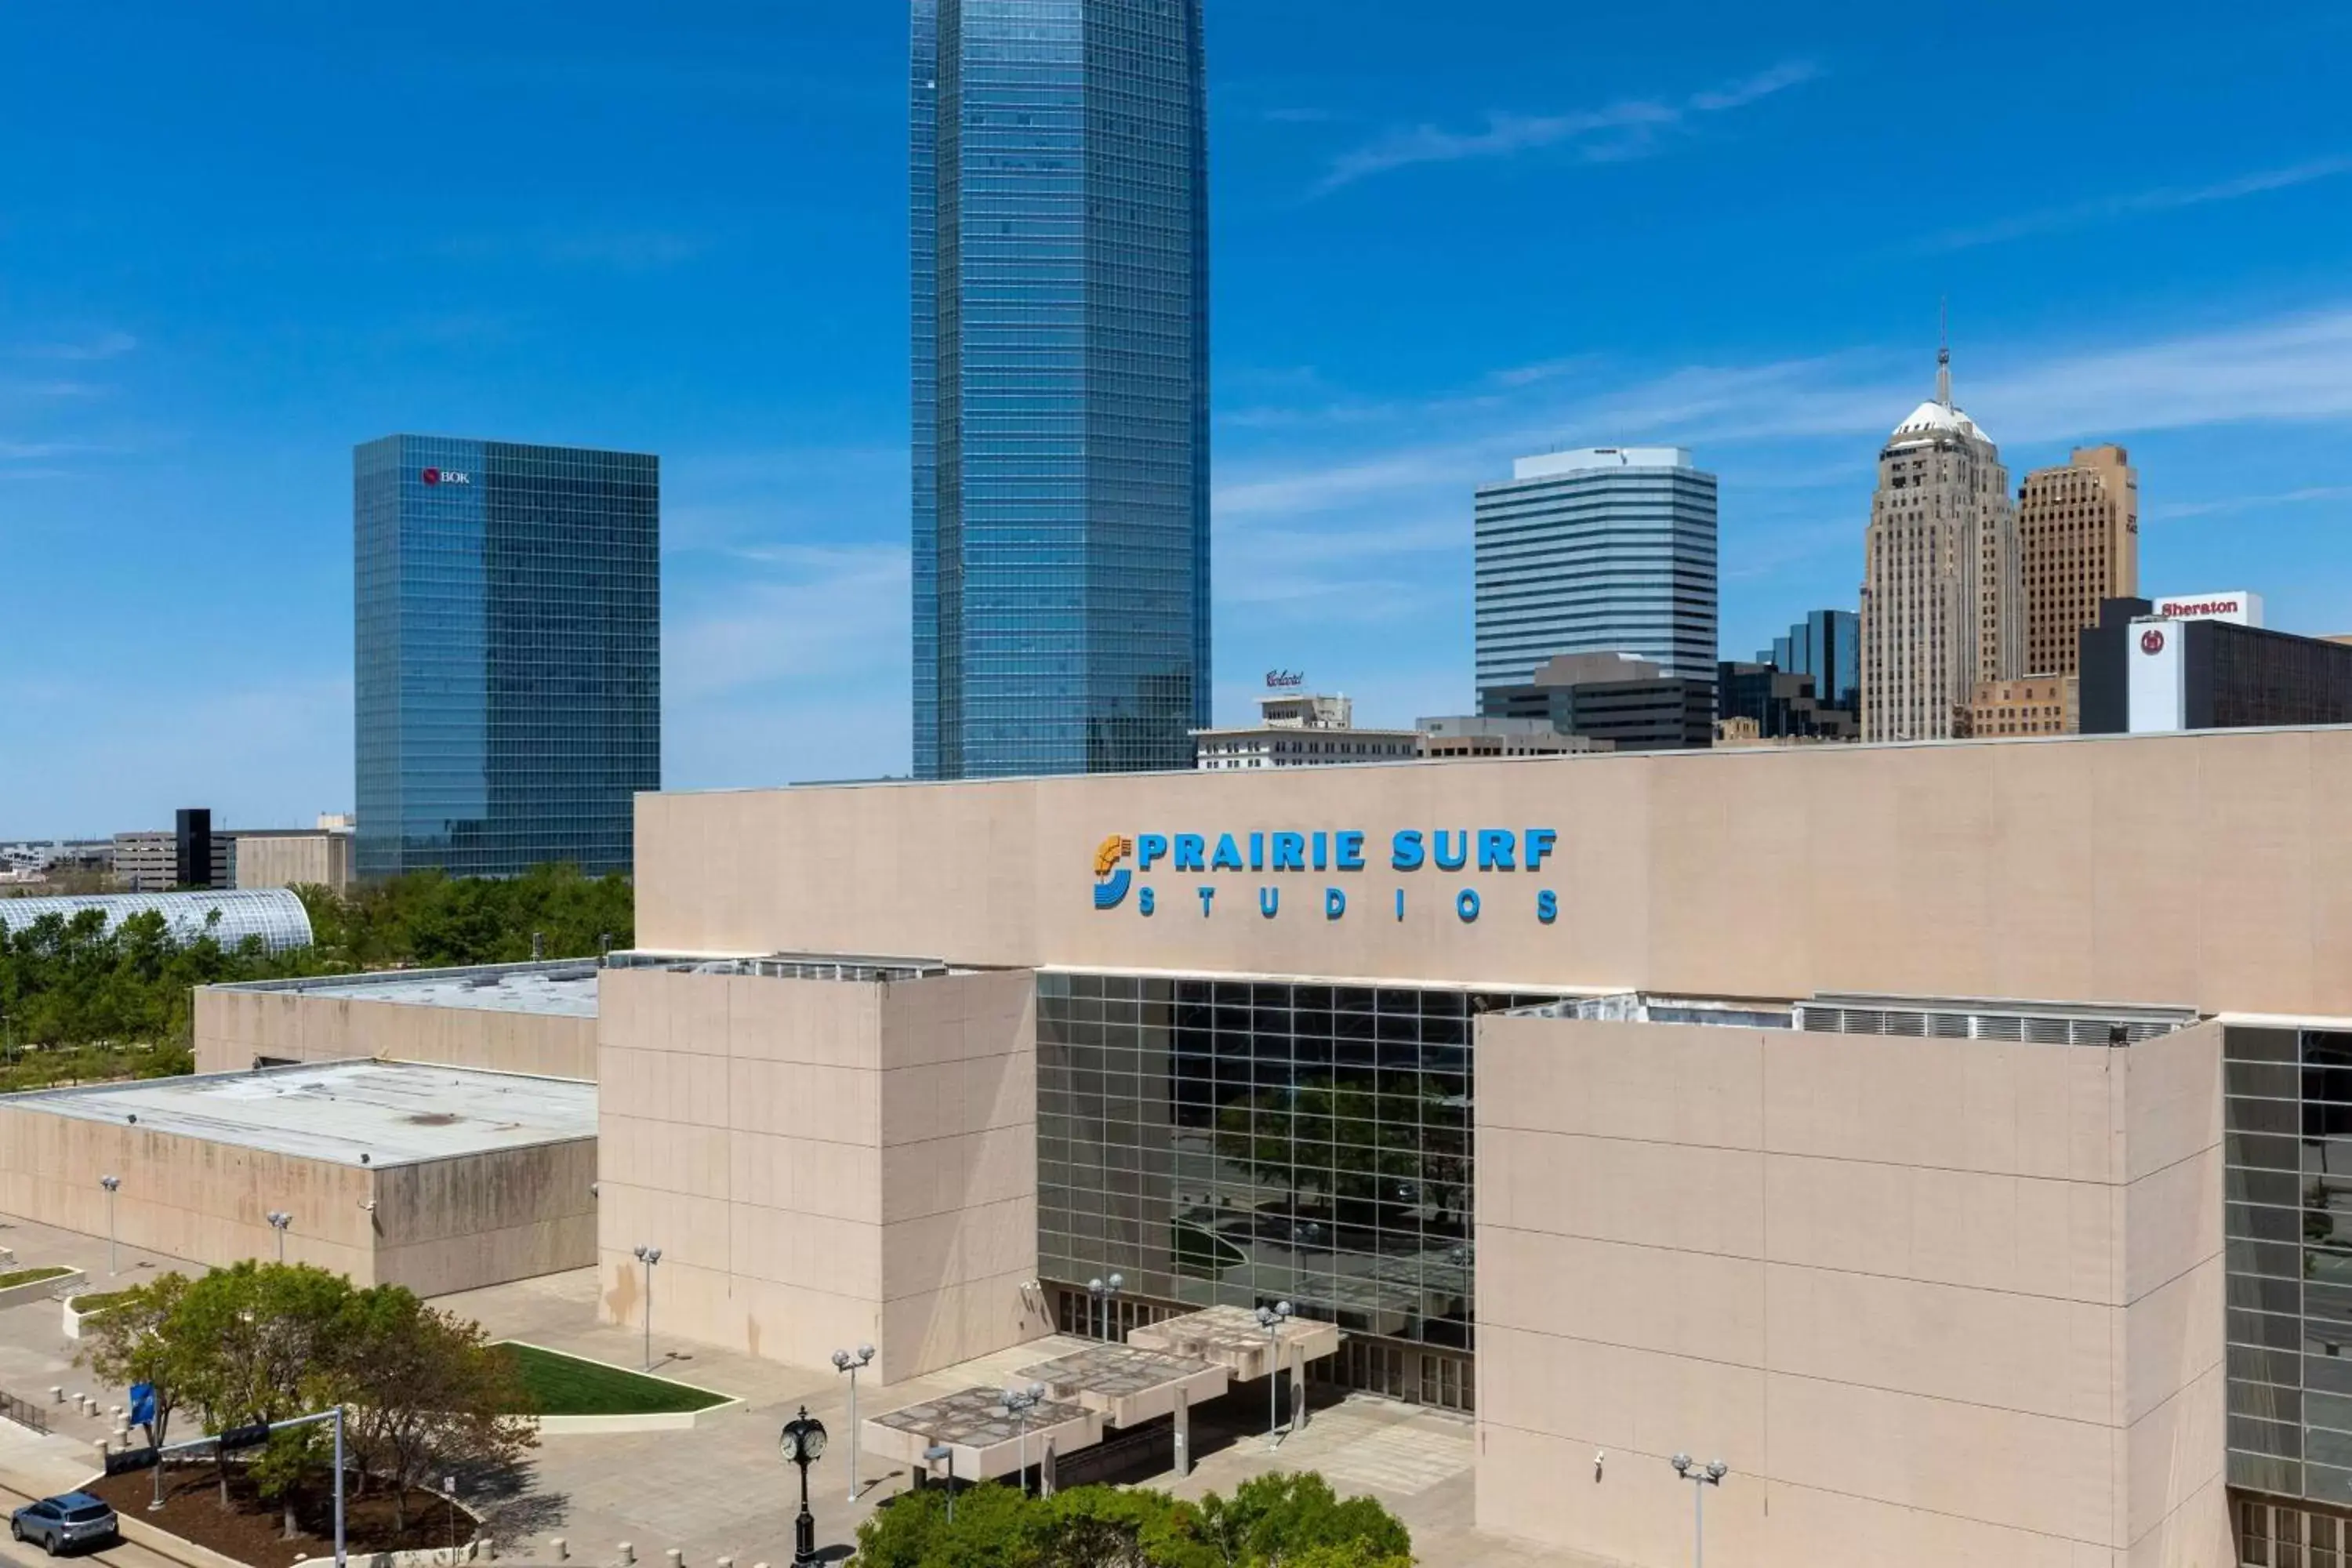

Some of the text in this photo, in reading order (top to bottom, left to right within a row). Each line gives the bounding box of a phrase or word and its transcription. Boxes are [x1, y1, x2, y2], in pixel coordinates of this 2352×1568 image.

[441, 470, 470, 484] BOK
[2162, 601, 2238, 617] Sheraton
[1138, 829, 1558, 872] PRAIRIE SURF
[1138, 887, 1559, 924] STUDIOS
